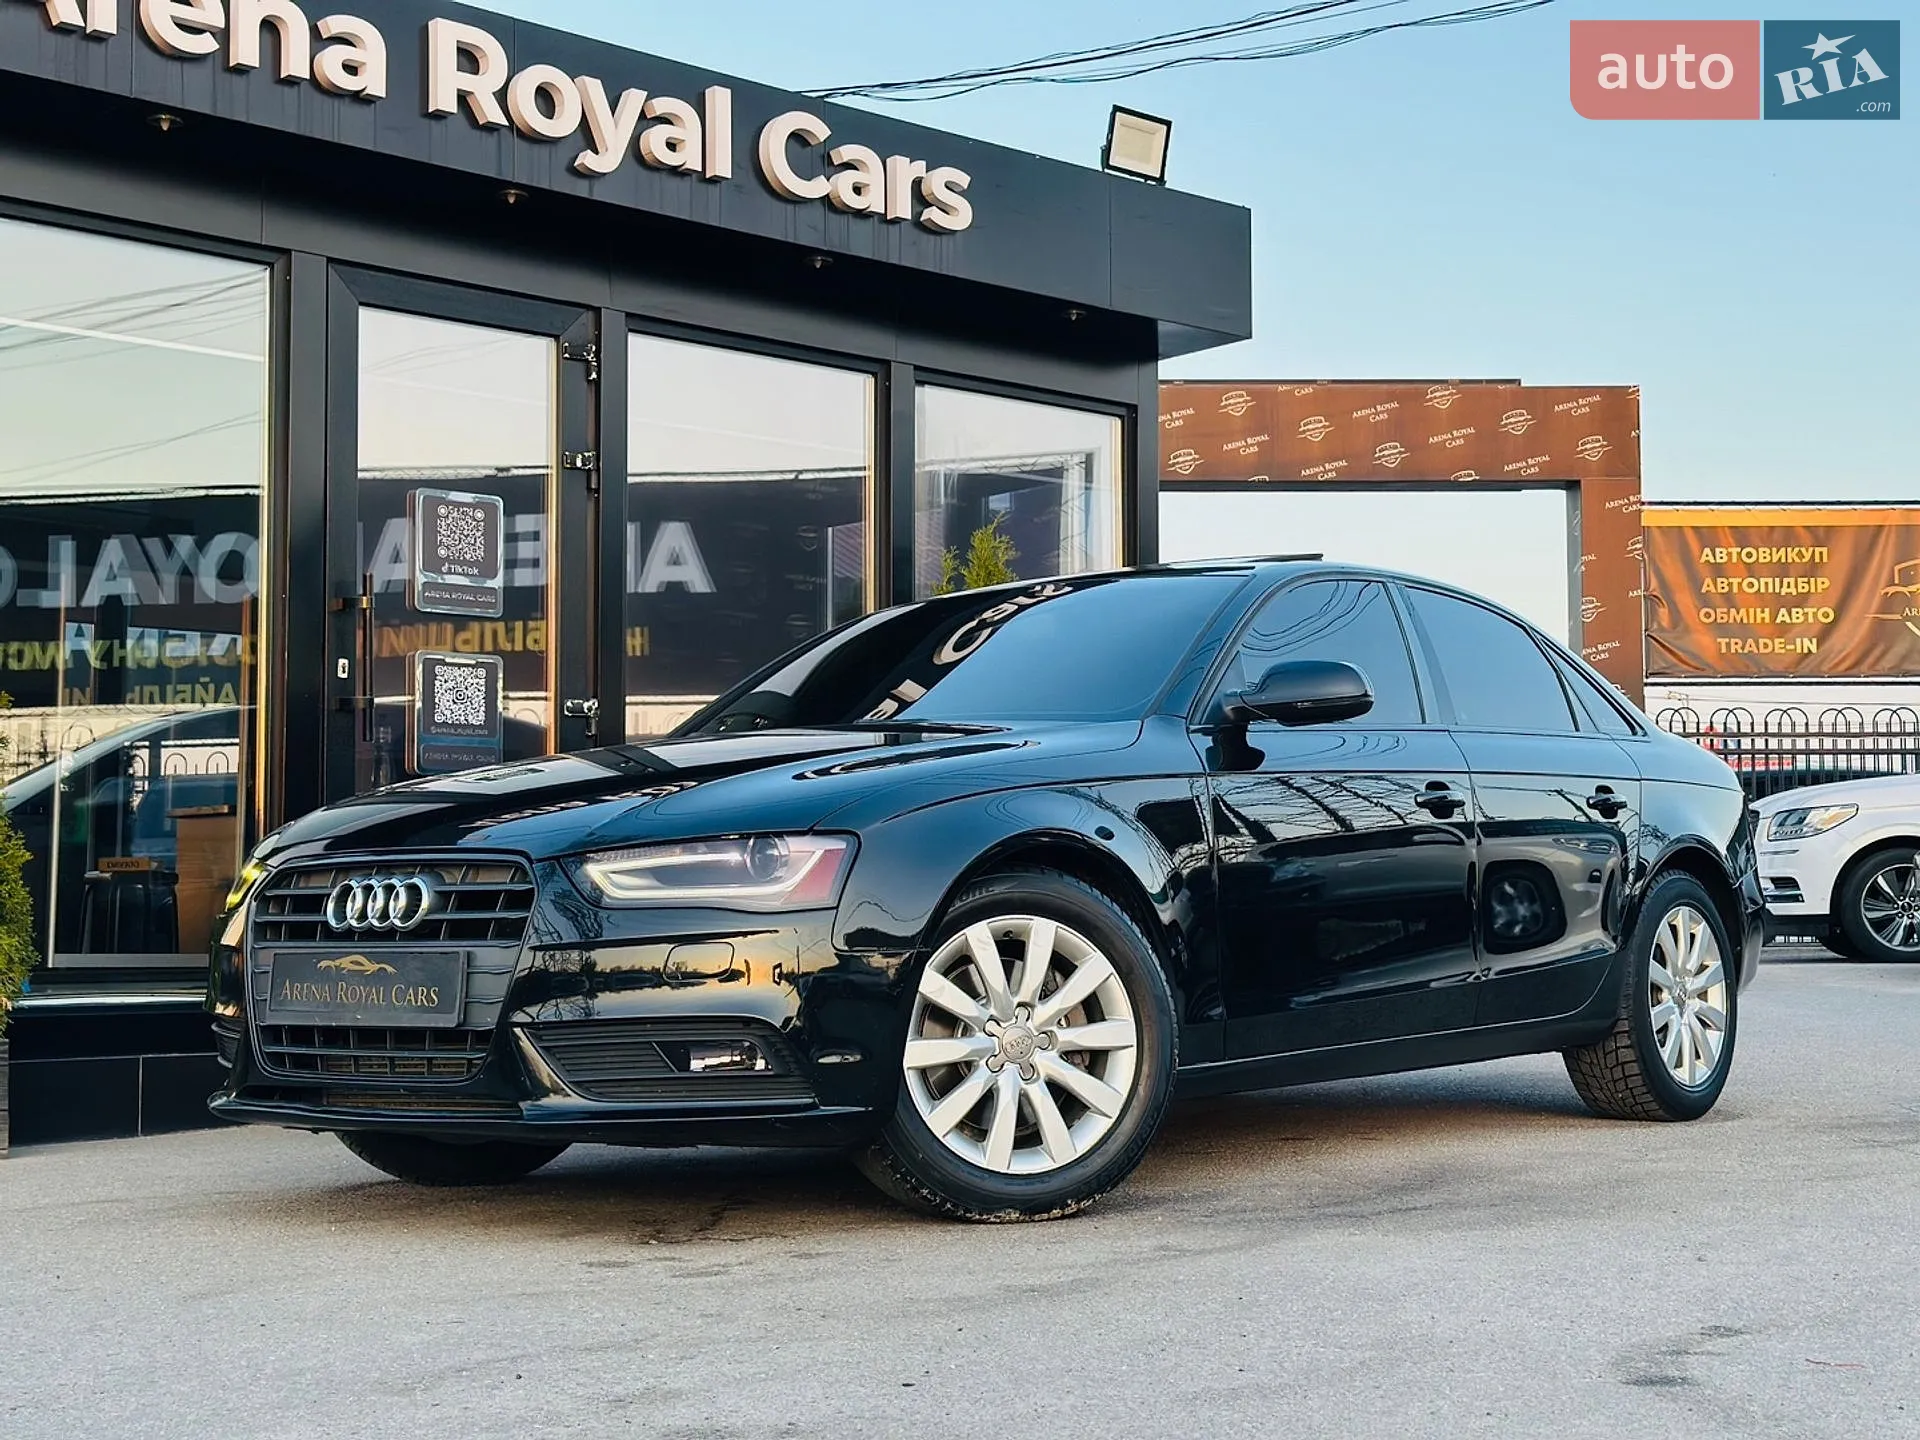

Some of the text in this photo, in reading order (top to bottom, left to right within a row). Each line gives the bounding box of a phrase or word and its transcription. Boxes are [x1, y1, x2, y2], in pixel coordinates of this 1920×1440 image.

[427, 17, 733, 182] Royal
[758, 110, 974, 234] Cars
[1352, 400, 1400, 419] ARENA ROYAL
[1369, 412, 1389, 423] CARS
[1222, 433, 1271, 452] ARENA ROYAL
[1428, 426, 1476, 444] ARENA ROYAL
[1445, 437, 1465, 448] CARS
[1239, 445, 1259, 455] CARS
[1301, 459, 1349, 477] ARENA ROYAL
[1503, 454, 1551, 472] ARENA ROYAL
[1520, 465, 1540, 476] CARS
[1699, 546, 1829, 564] АВТОВИКУП
[1701, 576, 1831, 596] АВТОПІДБІР
[1698, 606, 1835, 625] ОБМІН АВТО
[1717, 637, 1818, 654] TRADE-IN
[280, 978, 439, 1008] ARENA ROYAL CARS
